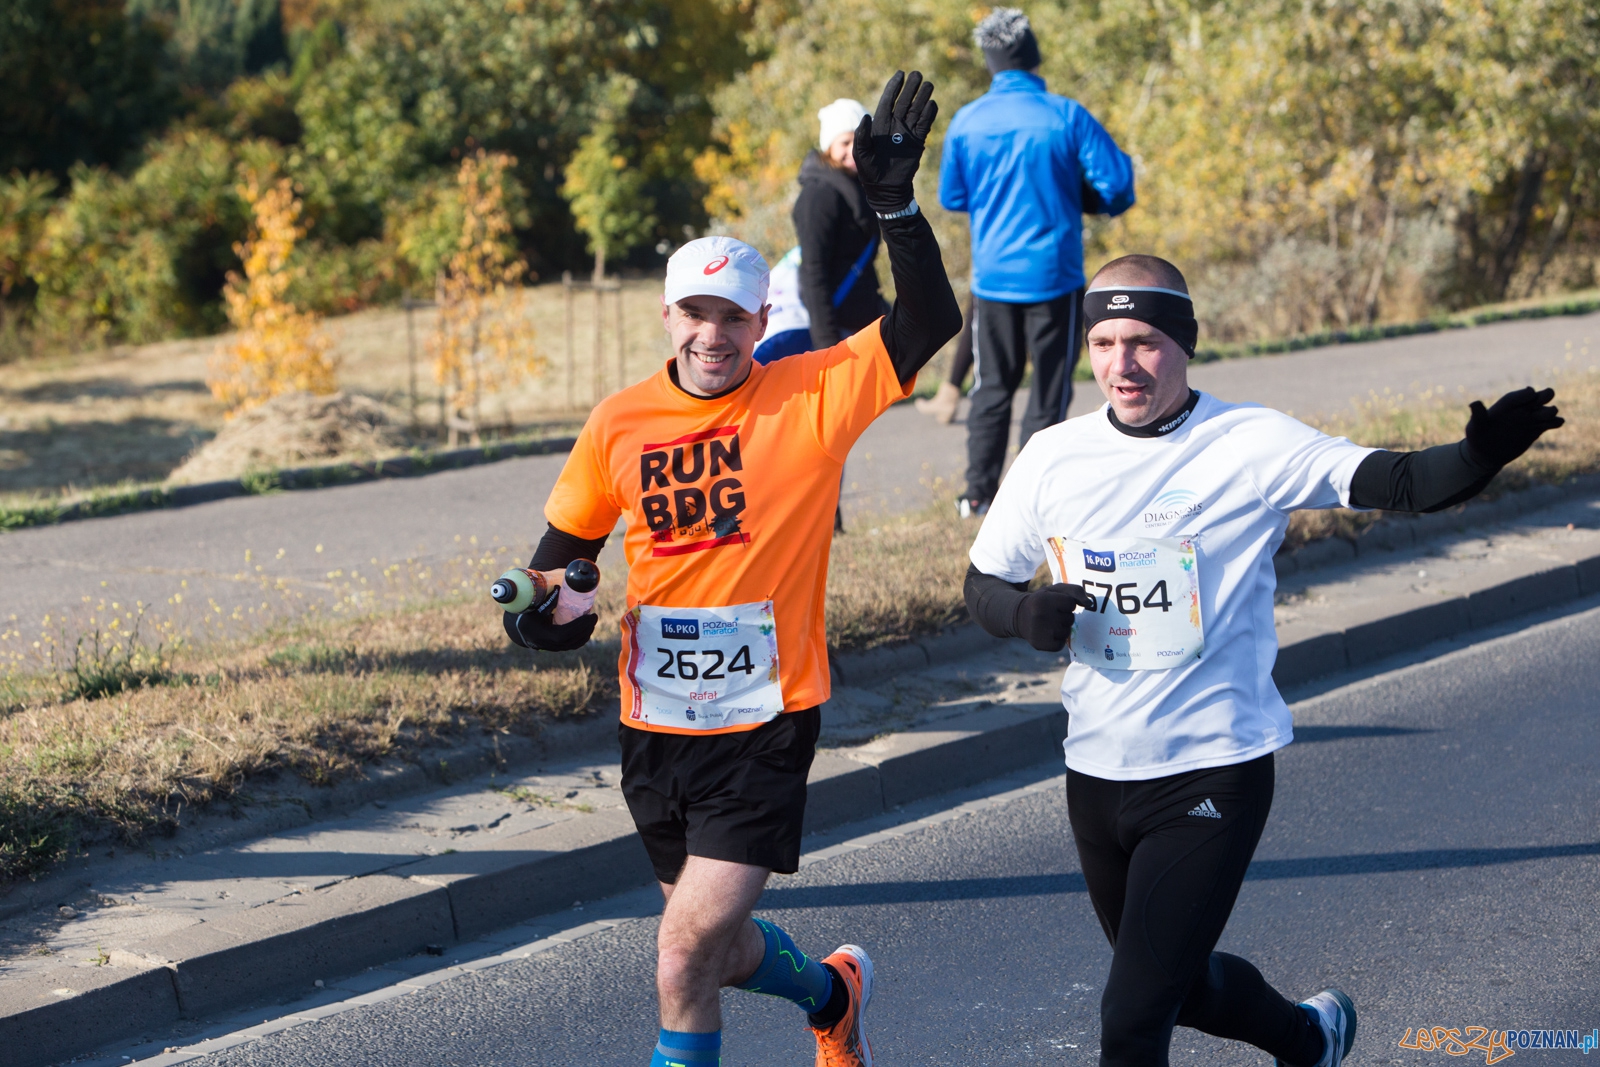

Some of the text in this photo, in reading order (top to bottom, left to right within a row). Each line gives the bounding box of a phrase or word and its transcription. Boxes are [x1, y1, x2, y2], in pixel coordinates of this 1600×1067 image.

[640, 432, 744, 493] RUN
[641, 477, 746, 533] BDG
[1120, 558, 1156, 567] maraton
[1082, 579, 1172, 614] 5764
[703, 627, 738, 636] maraton
[1109, 626, 1137, 636] Adam
[657, 645, 755, 681] 2624
[689, 691, 717, 701] Rafał
[1187, 810, 1222, 819] adidas
